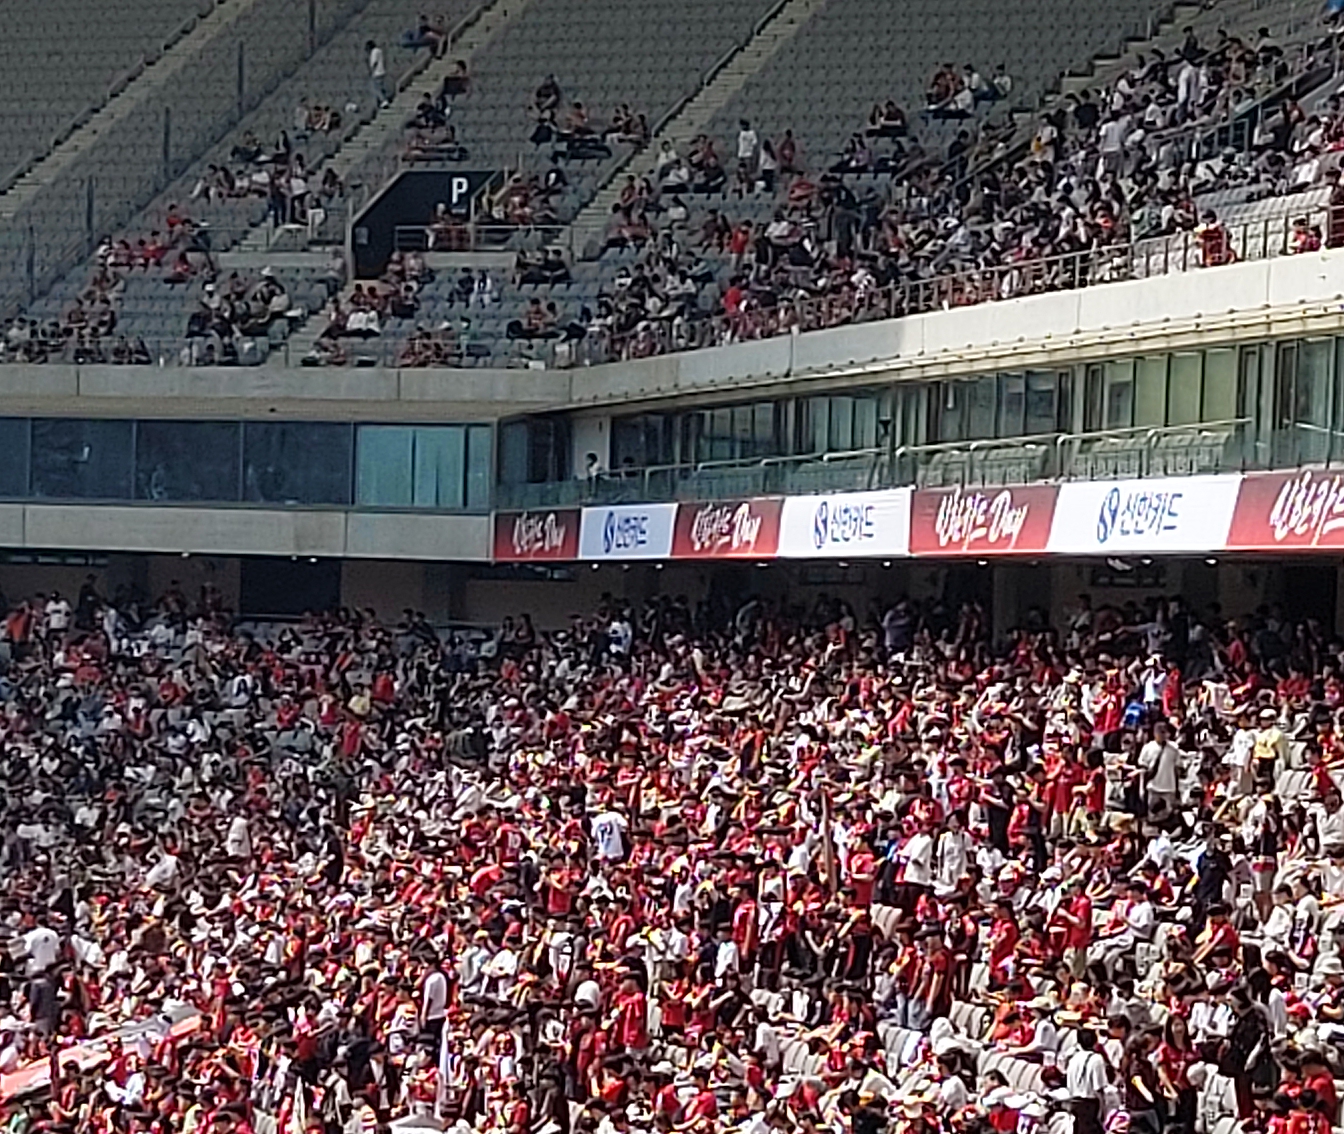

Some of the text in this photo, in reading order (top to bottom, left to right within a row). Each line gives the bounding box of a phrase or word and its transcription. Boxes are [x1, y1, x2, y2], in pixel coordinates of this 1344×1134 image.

[452, 177, 469, 204] P
[830, 502, 876, 543] 신한카드
[987, 489, 1031, 551] Day
[1119, 490, 1184, 537] 신한카드
